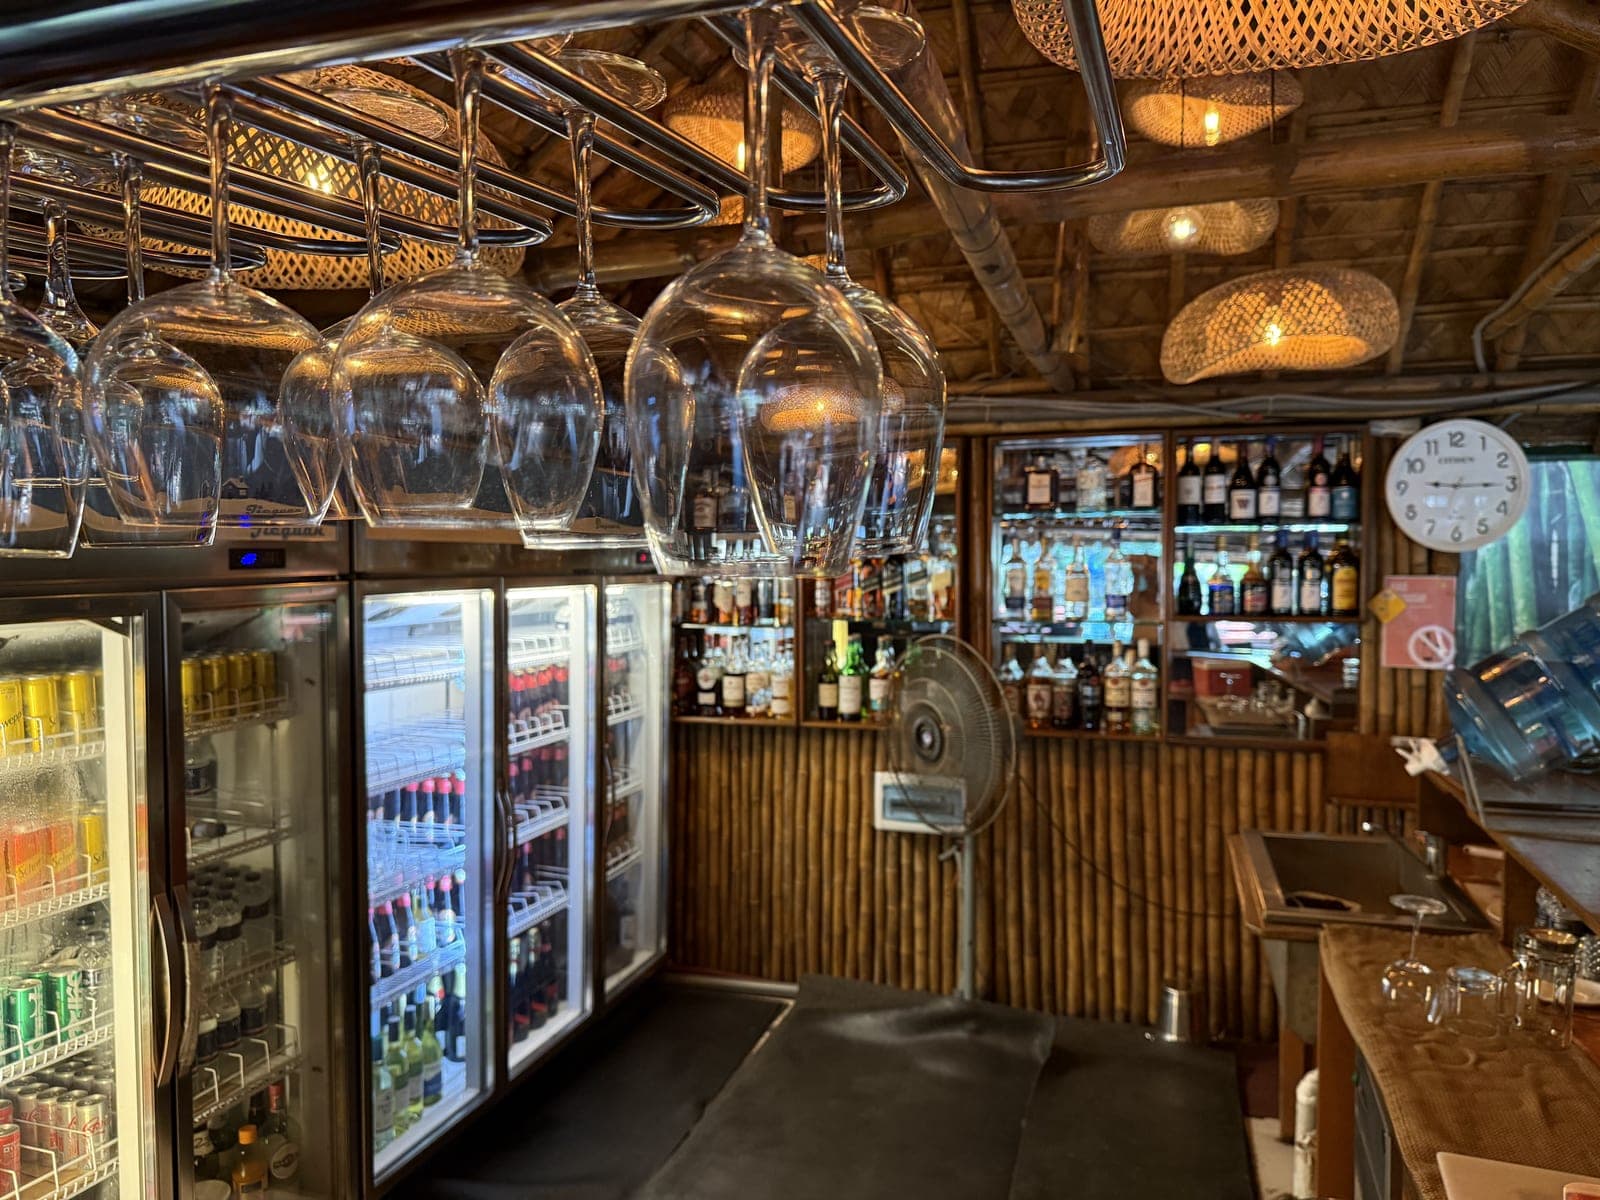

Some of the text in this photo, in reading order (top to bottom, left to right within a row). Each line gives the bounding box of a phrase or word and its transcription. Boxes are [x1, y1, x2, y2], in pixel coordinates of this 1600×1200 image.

[1425, 439, 1439, 455] 11
[1448, 430, 1465, 448] 12
[1480, 435, 1487, 451] 1
[1405, 457, 1425, 474] 10
[1496, 452, 1509, 468] 2
[1396, 480, 1409, 496] 9
[1506, 475, 1518, 492] 3
[1405, 504, 1417, 521] 8
[1496, 500, 1508, 516] 4
[1425, 518, 1436, 536] 7
[1451, 525, 1463, 542] 6
[1476, 518, 1489, 535] 5
